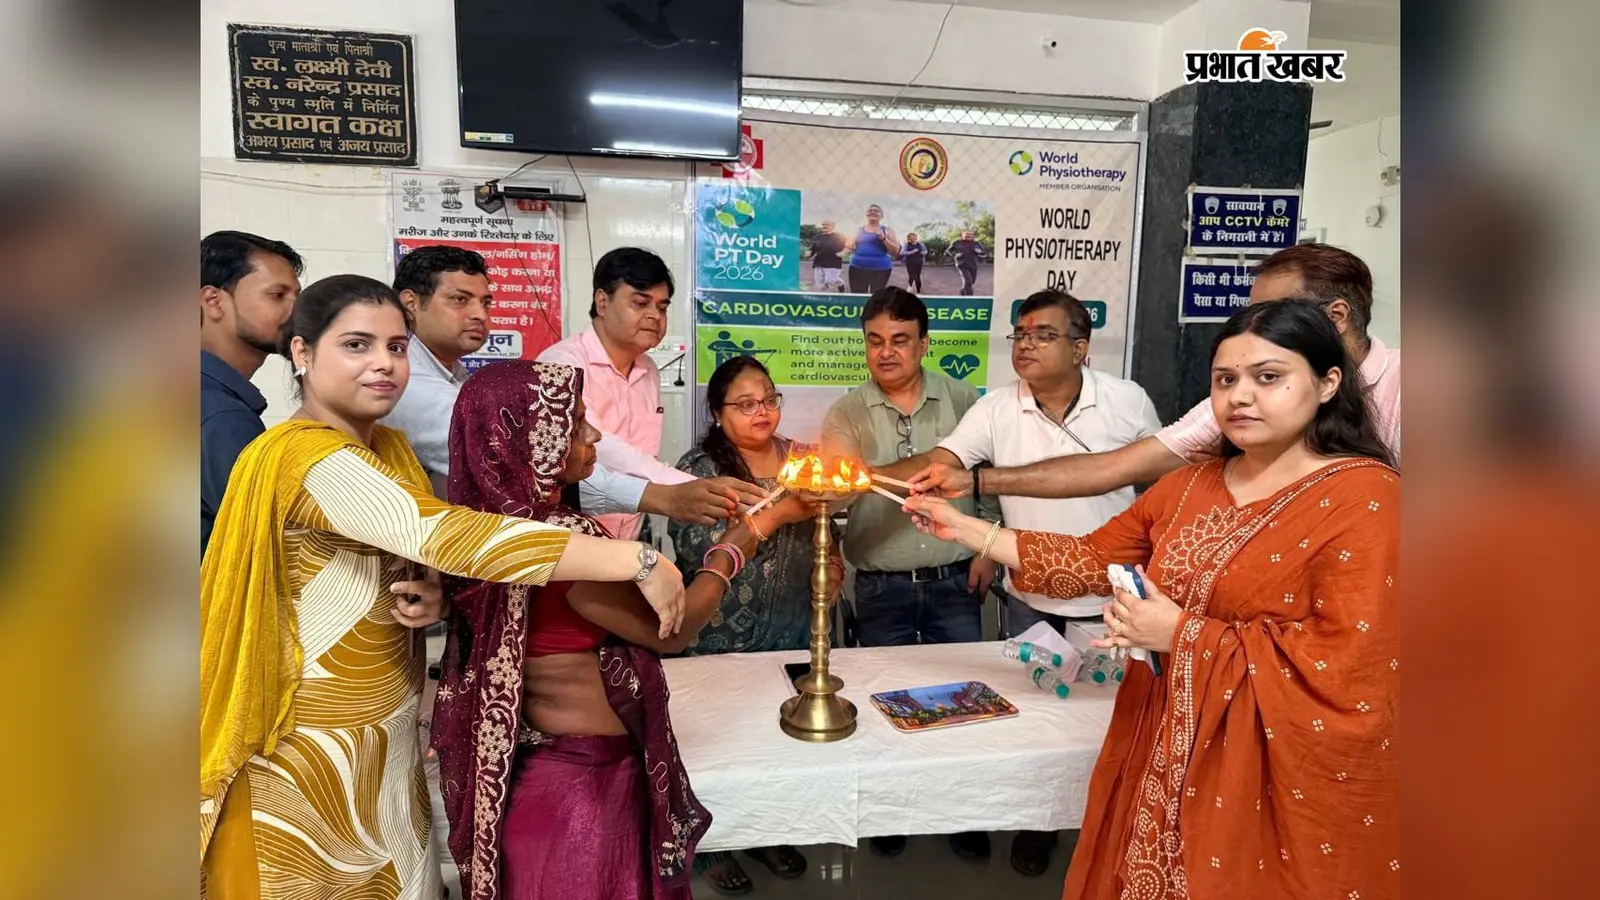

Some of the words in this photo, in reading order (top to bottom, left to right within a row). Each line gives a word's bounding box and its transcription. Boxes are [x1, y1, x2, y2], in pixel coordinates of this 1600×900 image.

[326, 41, 339, 56] एवं
[250, 56, 287, 71] स्व.
[294, 57, 349, 76] लक्ष्मी
[354, 59, 392, 78] देवी
[242, 75, 279, 90] स्व.
[285, 75, 341, 94] नरेन्द्र
[347, 82, 402, 97] प्रसाद
[247, 93, 260, 107] के
[269, 97, 295, 110] पुण्य
[304, 95, 335, 113] स्मृति
[343, 97, 354, 112] में
[362, 99, 399, 115] निर्मित
[246, 112, 342, 134] स्वागत
[348, 117, 403, 137] कक्ष
[245, 135, 278, 148] अभय
[281, 137, 315, 150] प्रसाद
[320, 138, 333, 152] एवं
[338, 139, 370, 152] अजय
[373, 141, 406, 154] प्रसाद
[1039, 152, 1078, 164] World
[1039, 165, 1126, 182] Physiotherapy
[1039, 183, 1069, 191] MEMBER
[1071, 184, 1121, 192] ORGANISATION
[1225, 201, 1266, 211] सावधान
[441, 215, 483, 228] महत्वपूर्ण
[1039, 208, 1091, 230] WORLD
[1199, 215, 1221, 226] आप
[1225, 216, 1262, 227] CCTV
[398, 226, 427, 236] मरीज
[430, 226, 449, 237] और
[452, 228, 478, 238] उनके
[480, 229, 519, 240] रिश्तेदार
[522, 231, 531, 240] के
[534, 230, 554, 241] लिए
[713, 233, 777, 249] World
[1201, 229, 1214, 241] के
[1216, 230, 1257, 242] निगरानी
[1260, 231, 1271, 242] में
[1005, 238, 1121, 261] PHYSIOTHERAPY
[715, 249, 742, 264] PT
[746, 250, 784, 269] Day
[714, 266, 764, 281] 2026
[1047, 270, 1076, 290] DAY
[1192, 271, 1216, 286] किसी
[1219, 272, 1231, 286] भी
[1193, 293, 1213, 307] पैसा
[1214, 296, 1227, 307] या
[702, 302, 863, 318] CARDIOVASCU
[928, 308, 989, 320] SEASE
[490, 316, 518, 325] पराध
[791, 335, 819, 345] Find
[824, 336, 844, 345] out
[848, 335, 864, 345] ho
[929, 338, 978, 346] become
[791, 349, 822, 358] more
[827, 347, 865, 358] active
[790, 360, 812, 369] and
[817, 361, 868, 372] manage
[790, 371, 870, 381] cardiovascul
